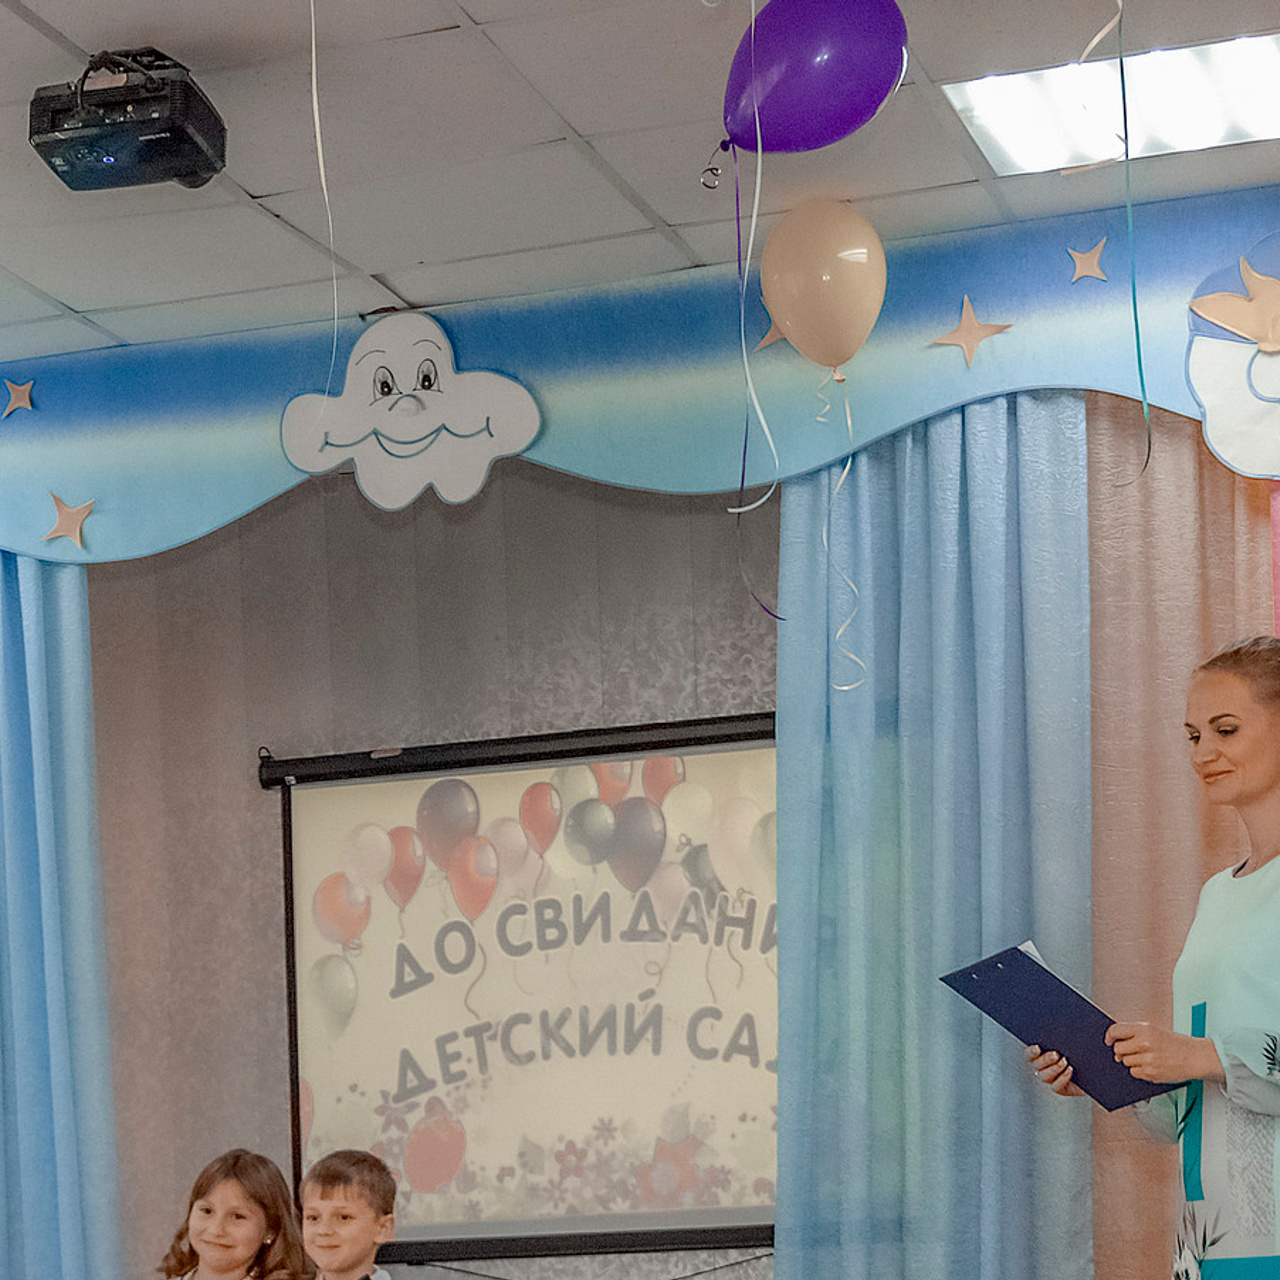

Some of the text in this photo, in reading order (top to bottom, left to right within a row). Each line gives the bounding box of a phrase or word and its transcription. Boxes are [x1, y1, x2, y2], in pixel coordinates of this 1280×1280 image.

[388, 920, 476, 999] ДО
[391, 988, 778, 1104] ДЕТСКИЙ СА
